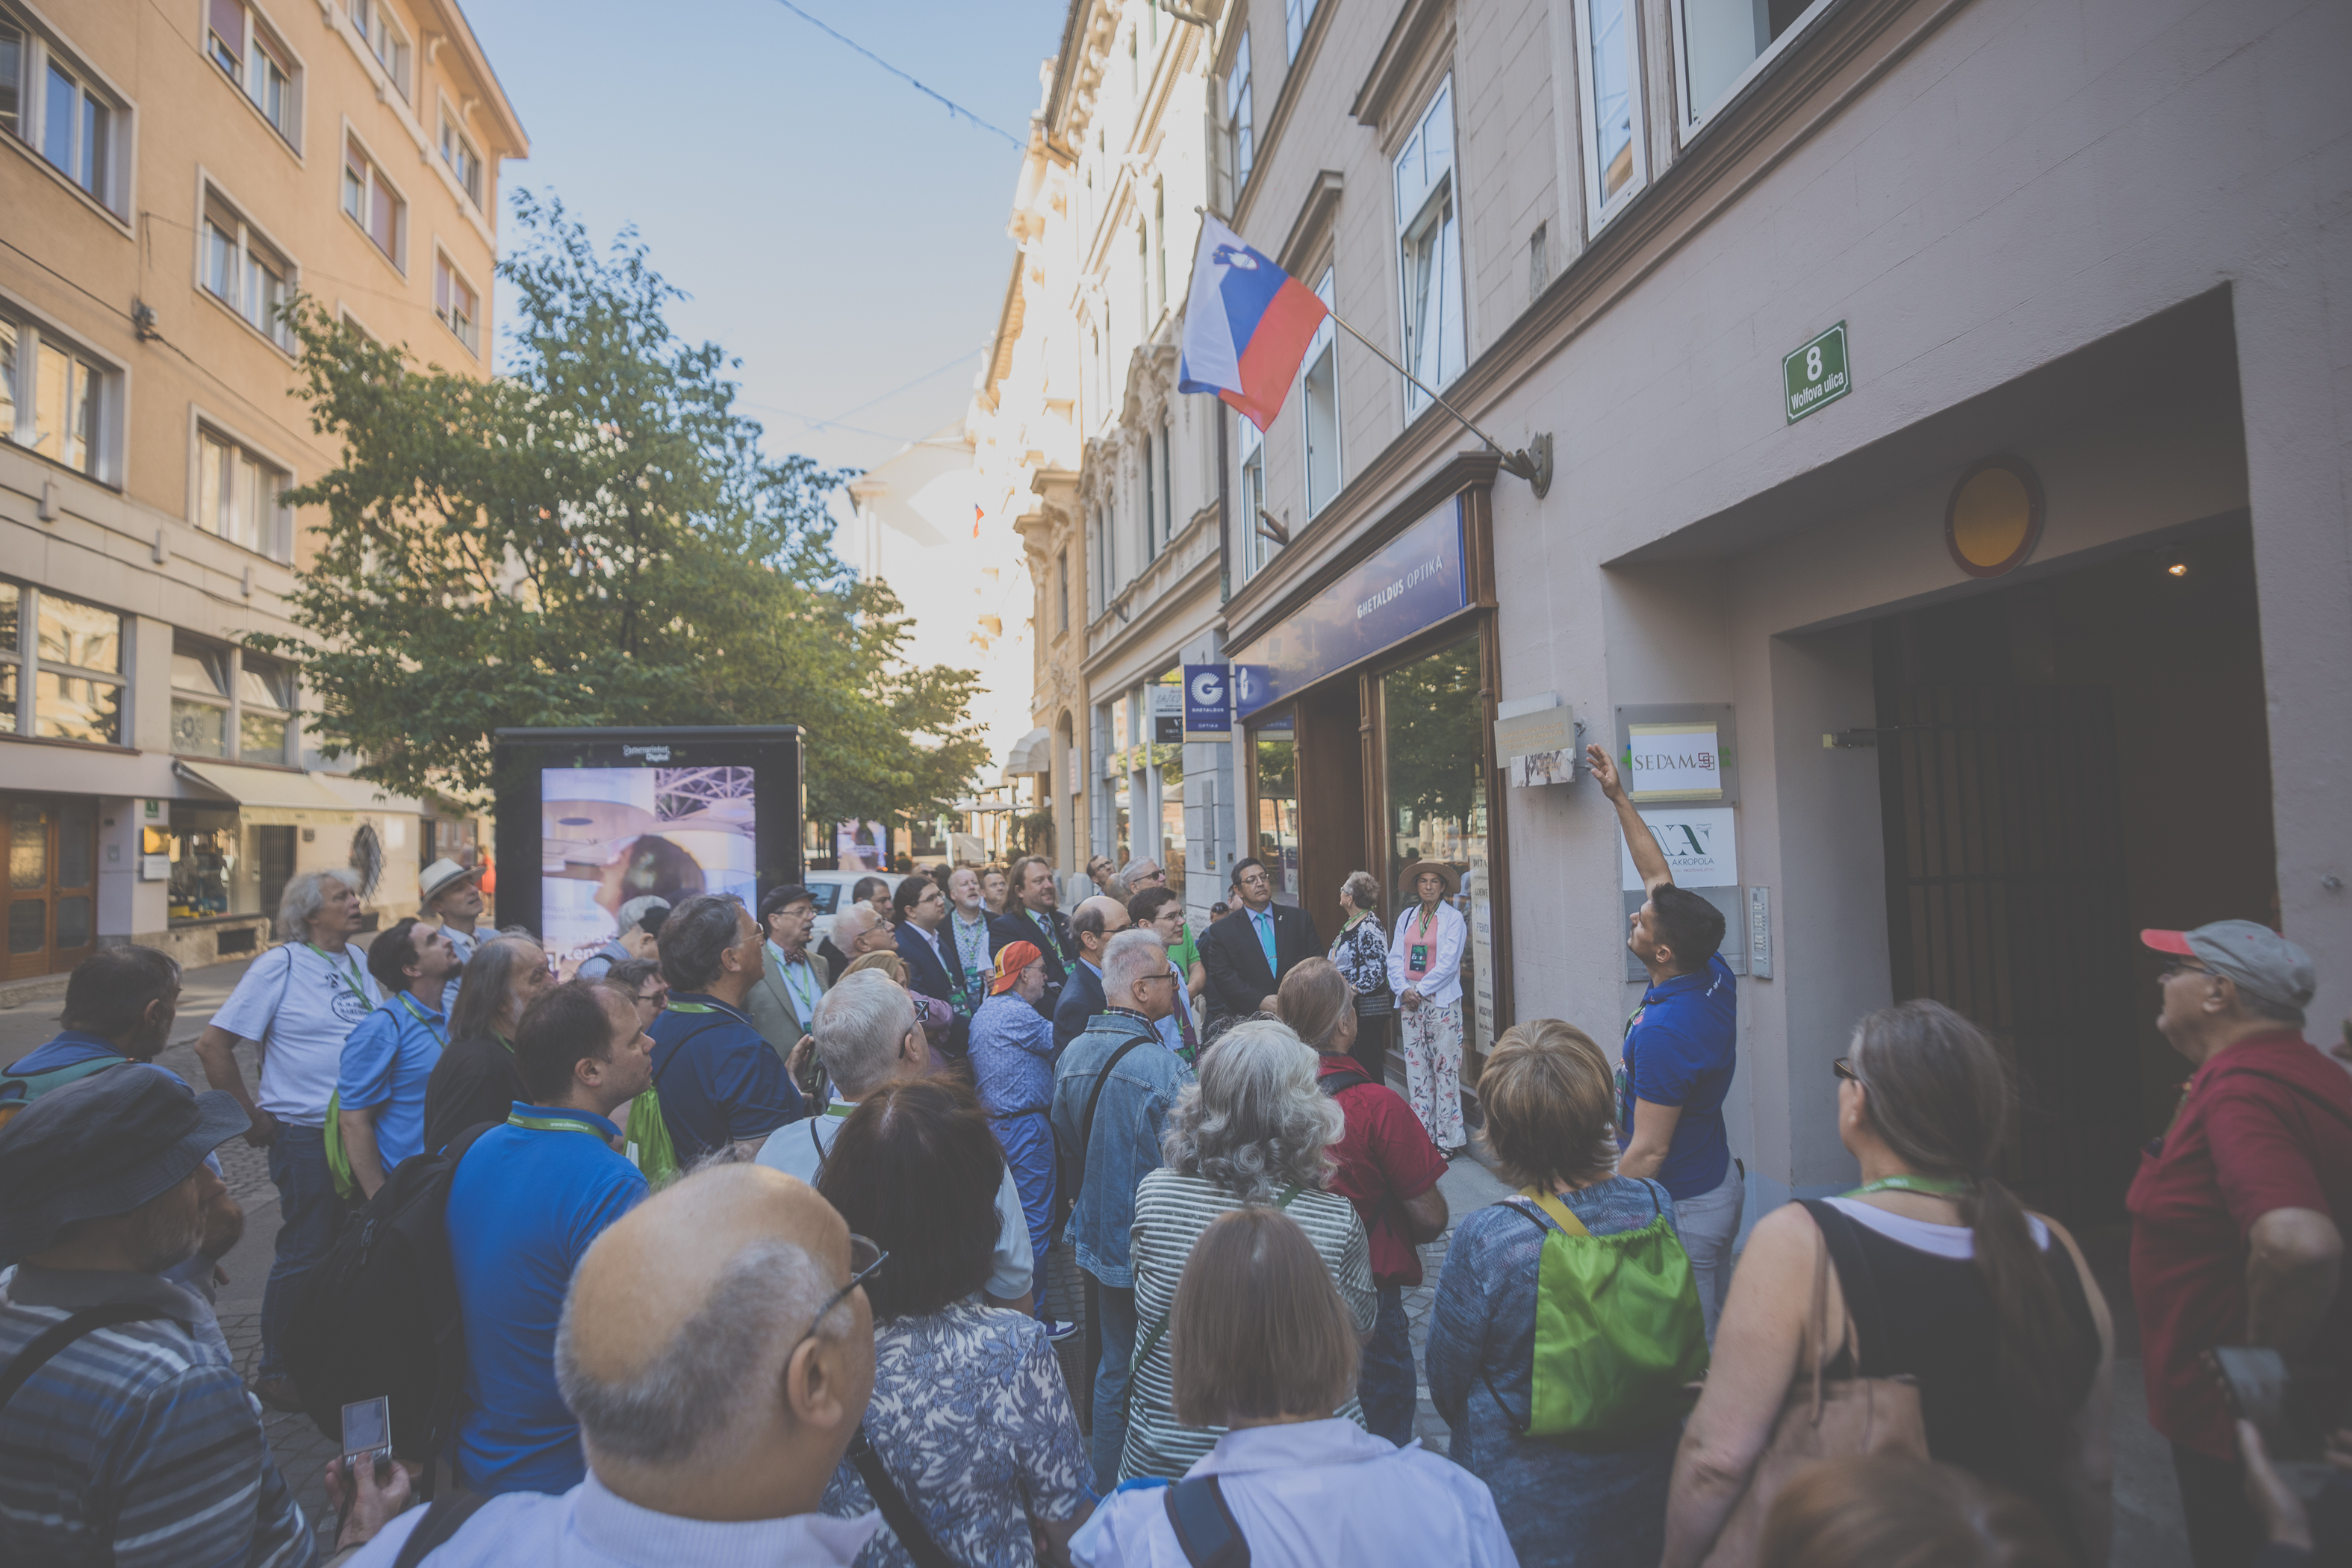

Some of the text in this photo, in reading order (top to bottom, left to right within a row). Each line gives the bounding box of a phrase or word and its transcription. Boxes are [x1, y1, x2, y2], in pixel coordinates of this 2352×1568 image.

[1806, 346, 1823, 382] 8
[1791, 371, 1844, 410] Wolfova ulica
[1357, 554, 1443, 619] GHETALDUS OPTIKA
[1473, 859, 1487, 868] DITA
[1672, 857, 1714, 866] AKROPOLA
[1475, 887, 1488, 897] LOEWE
[1476, 922, 1489, 933] FENDI
